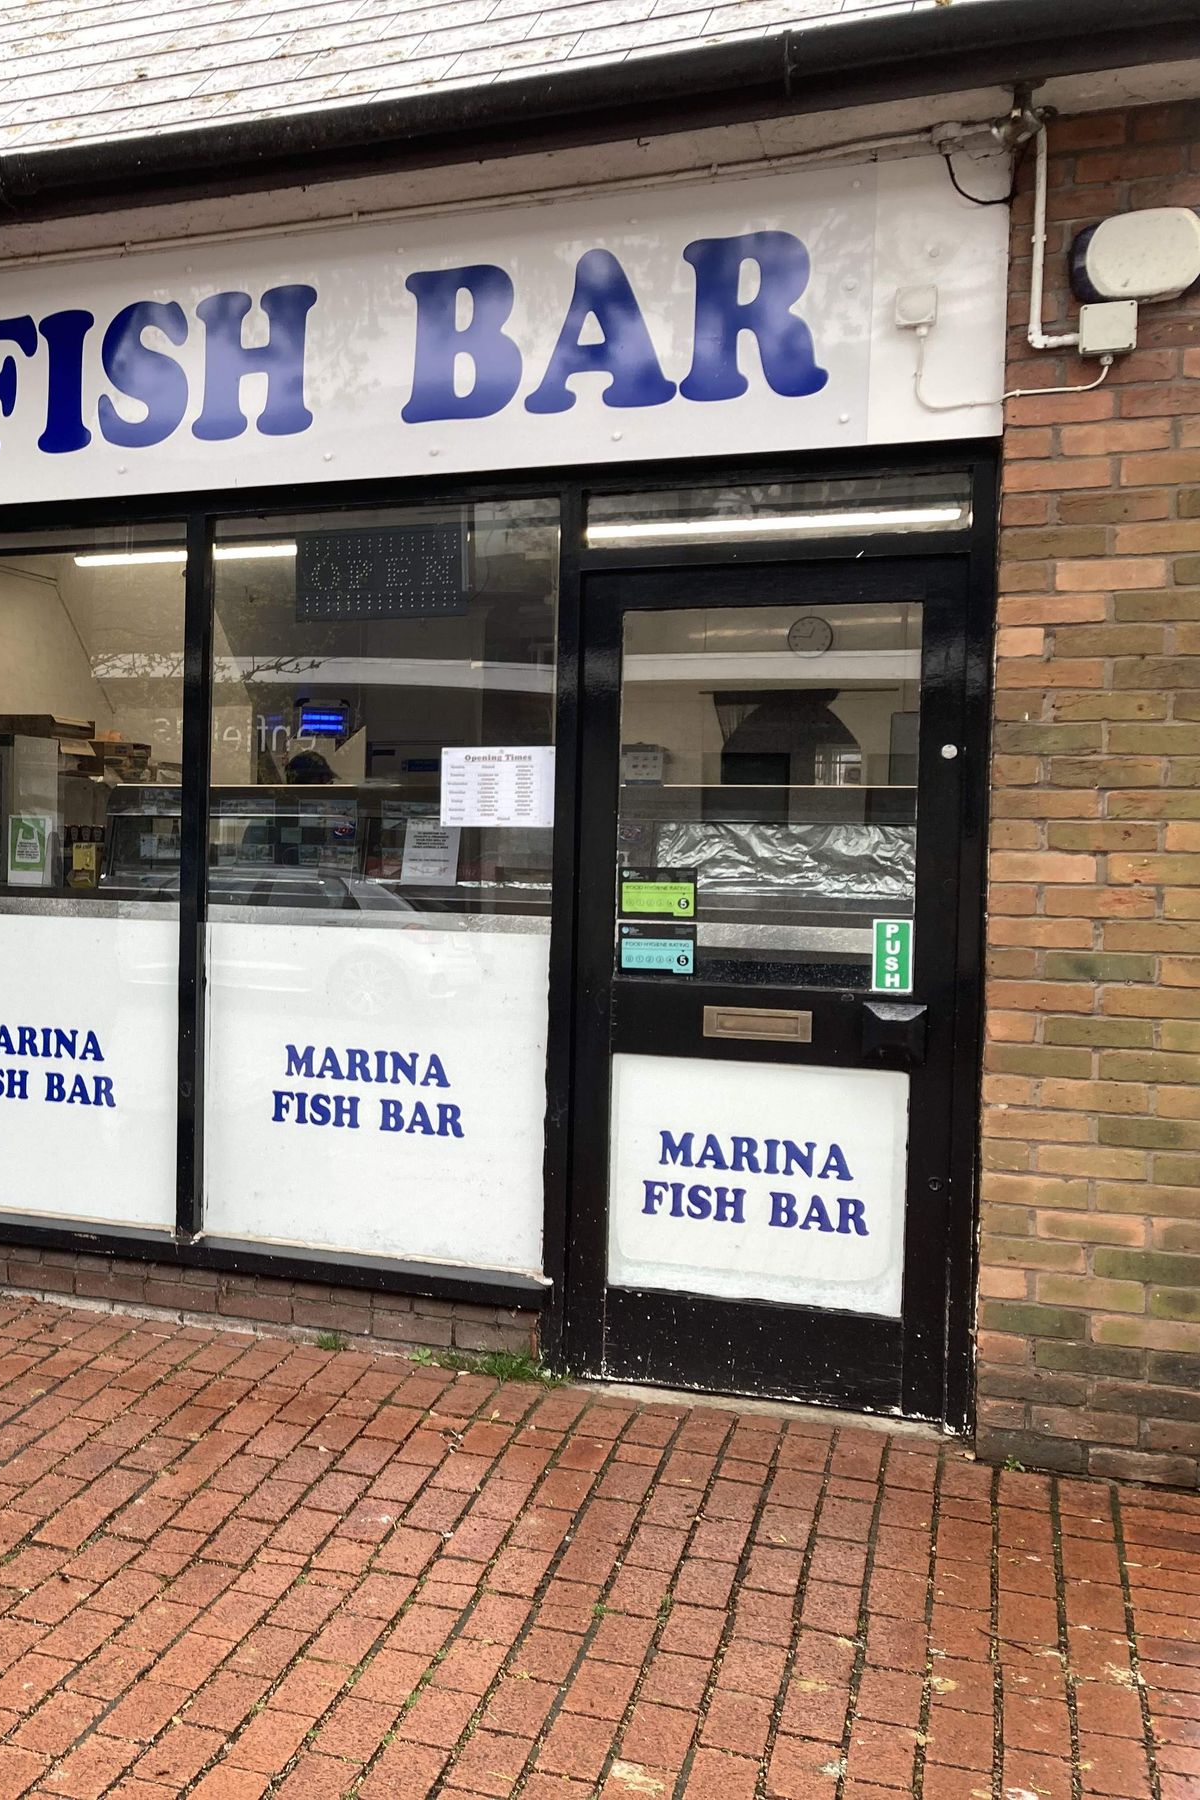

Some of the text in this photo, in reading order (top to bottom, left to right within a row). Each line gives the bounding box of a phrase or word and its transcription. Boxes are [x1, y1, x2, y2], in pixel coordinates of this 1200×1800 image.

[402, 230, 829, 424] BAR
[311, 555, 454, 591] OPEN
[464, 754, 503, 762] Opening
[680, 898, 687, 908] 5
[679, 955, 686, 965] 5
[884, 924, 901, 988] PUSH
[286, 1044, 451, 1089] MARINA
[44, 1072, 116, 1108] BAR
[272, 1090, 465, 1138] FISH BAR
[658, 1130, 854, 1182] MARINA
[641, 1180, 870, 1237] FISH BAR
